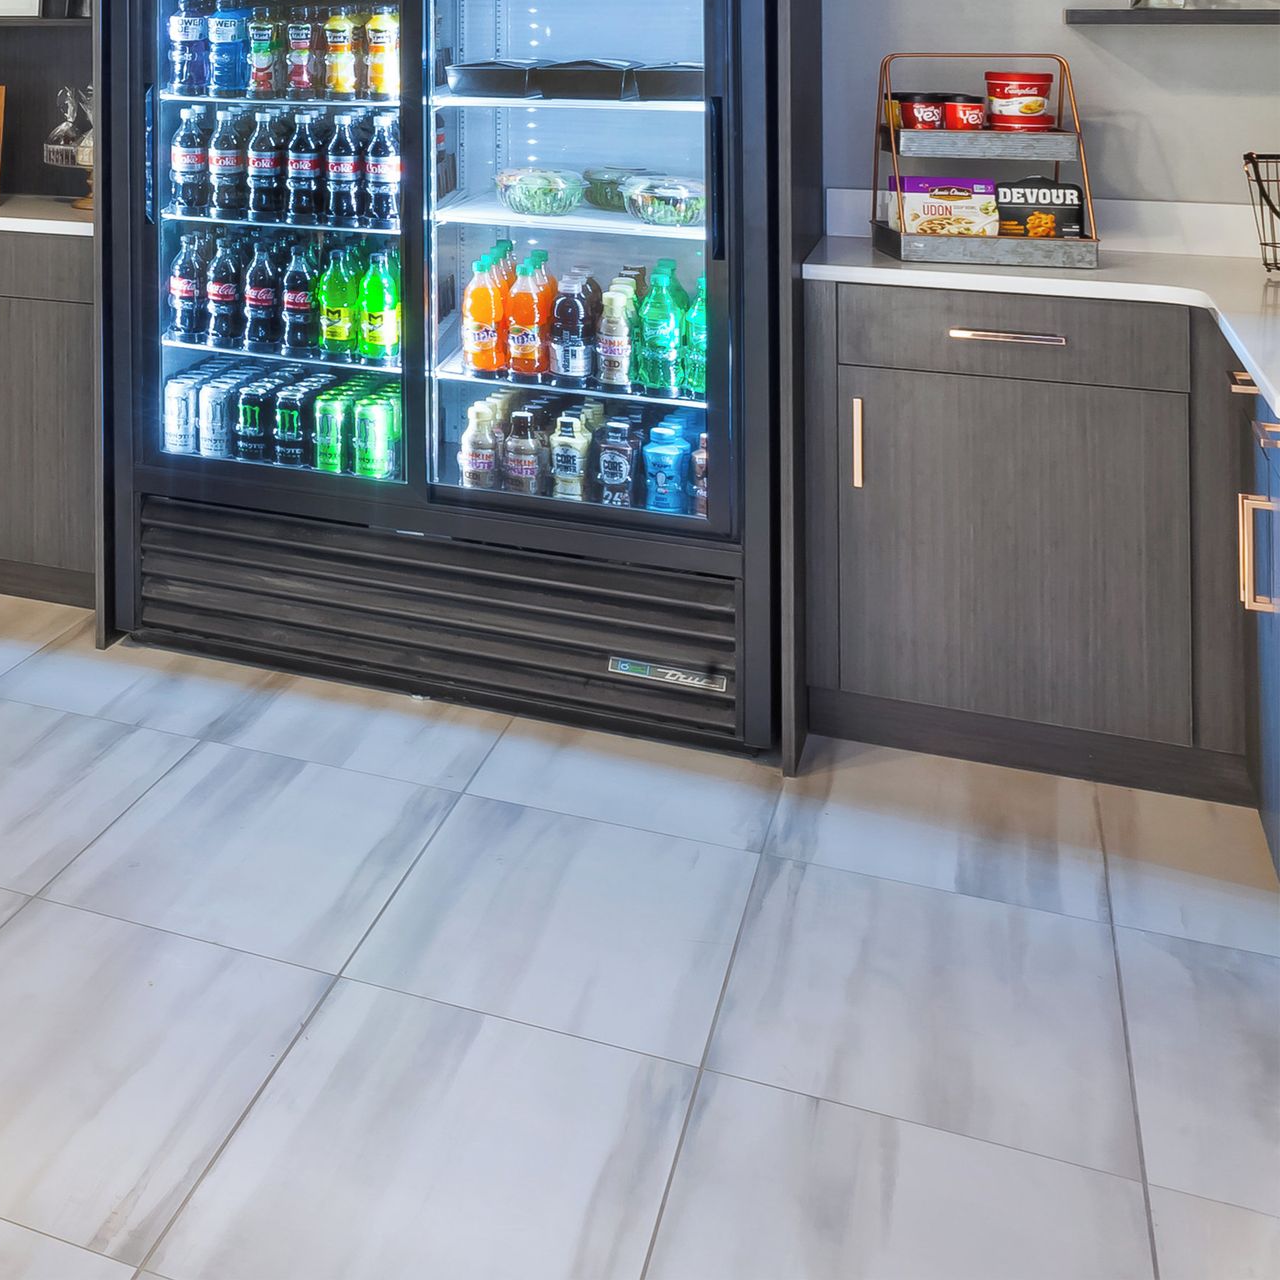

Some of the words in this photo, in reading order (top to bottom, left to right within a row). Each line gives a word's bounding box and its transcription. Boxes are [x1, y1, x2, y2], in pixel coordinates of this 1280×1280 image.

[249, 157, 274, 169] Coke
[998, 188, 1080, 205] DEVOUR
[922, 204, 953, 216] UDON
[555, 453, 577, 465] CORE
[602, 459, 624, 472] CORE
